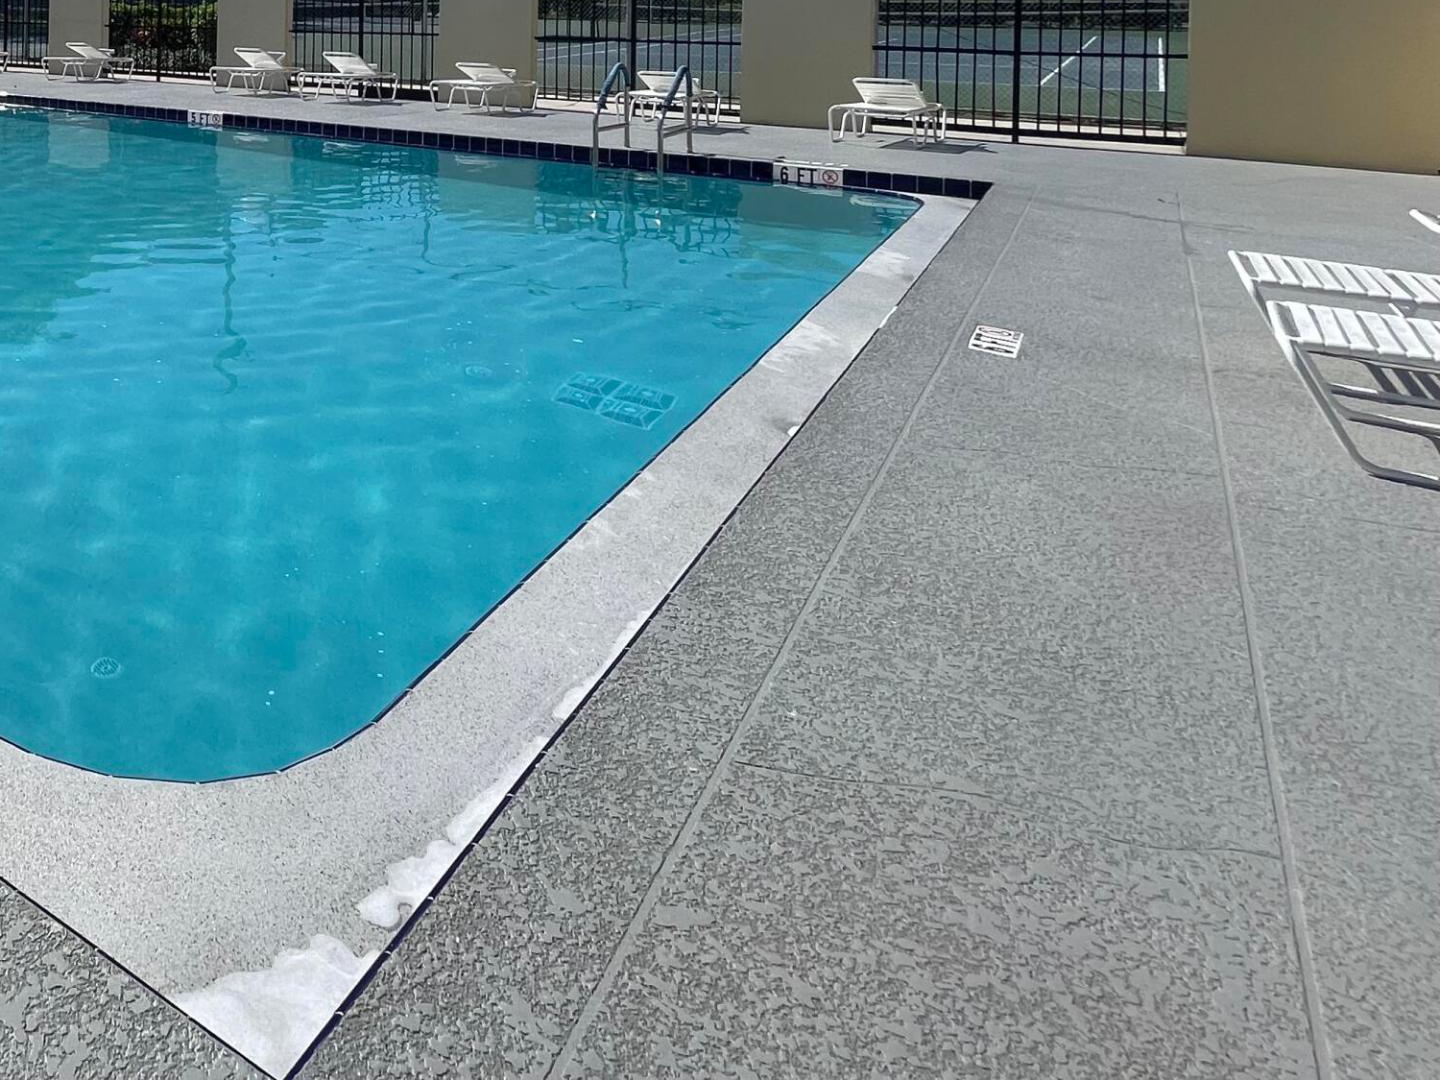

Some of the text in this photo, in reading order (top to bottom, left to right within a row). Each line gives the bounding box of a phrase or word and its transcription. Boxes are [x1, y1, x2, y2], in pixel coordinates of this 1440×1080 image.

[191, 111, 211, 126] 5 FT
[780, 166, 818, 184] 6 FT
